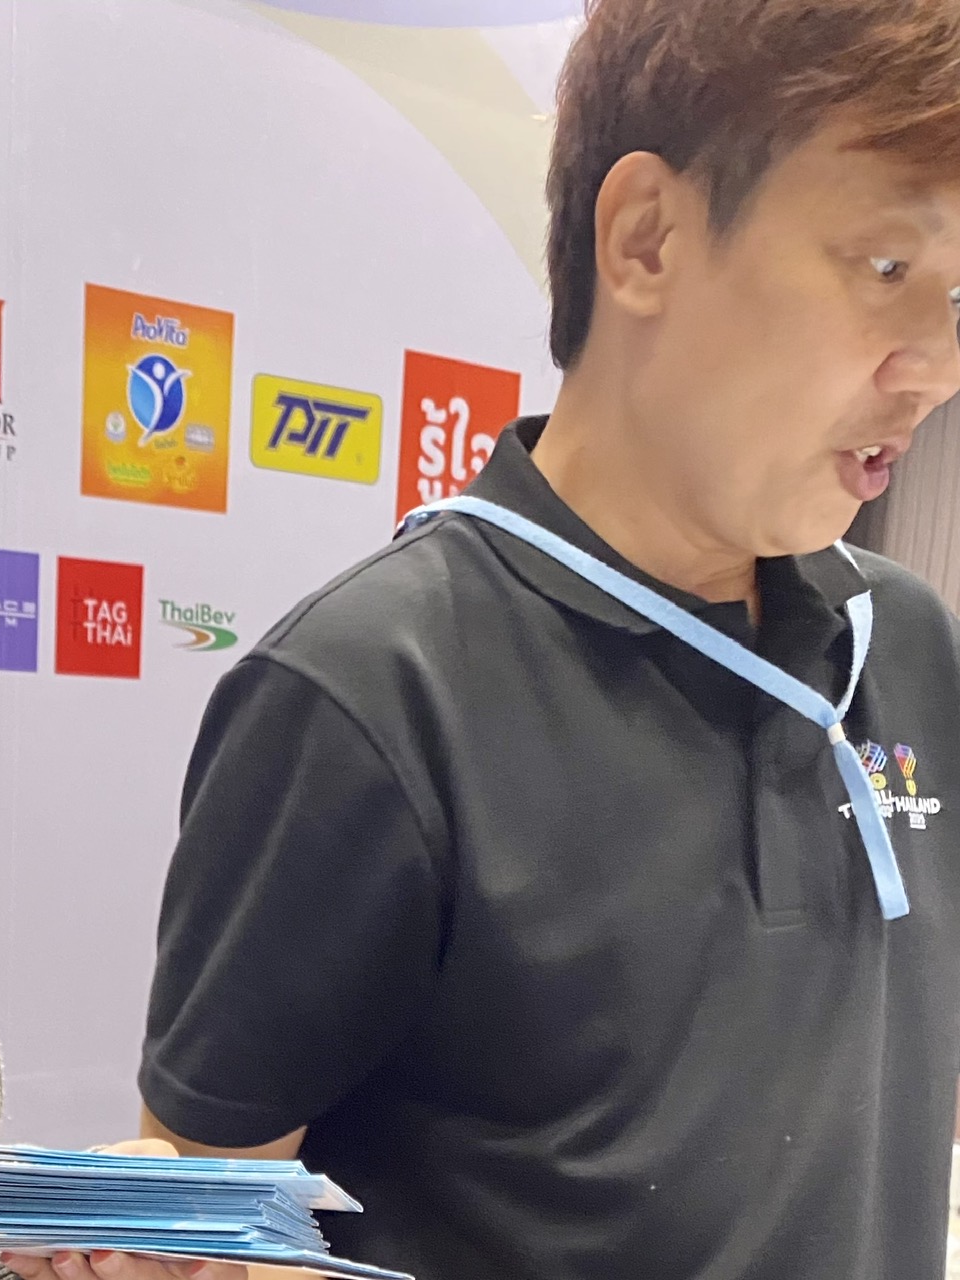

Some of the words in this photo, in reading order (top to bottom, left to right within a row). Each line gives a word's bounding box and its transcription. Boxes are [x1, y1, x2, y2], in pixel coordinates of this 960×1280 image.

[267, 390, 373, 460] PTT
[83, 598, 128, 625] TAG
[157, 598, 237, 626] ThaiBev
